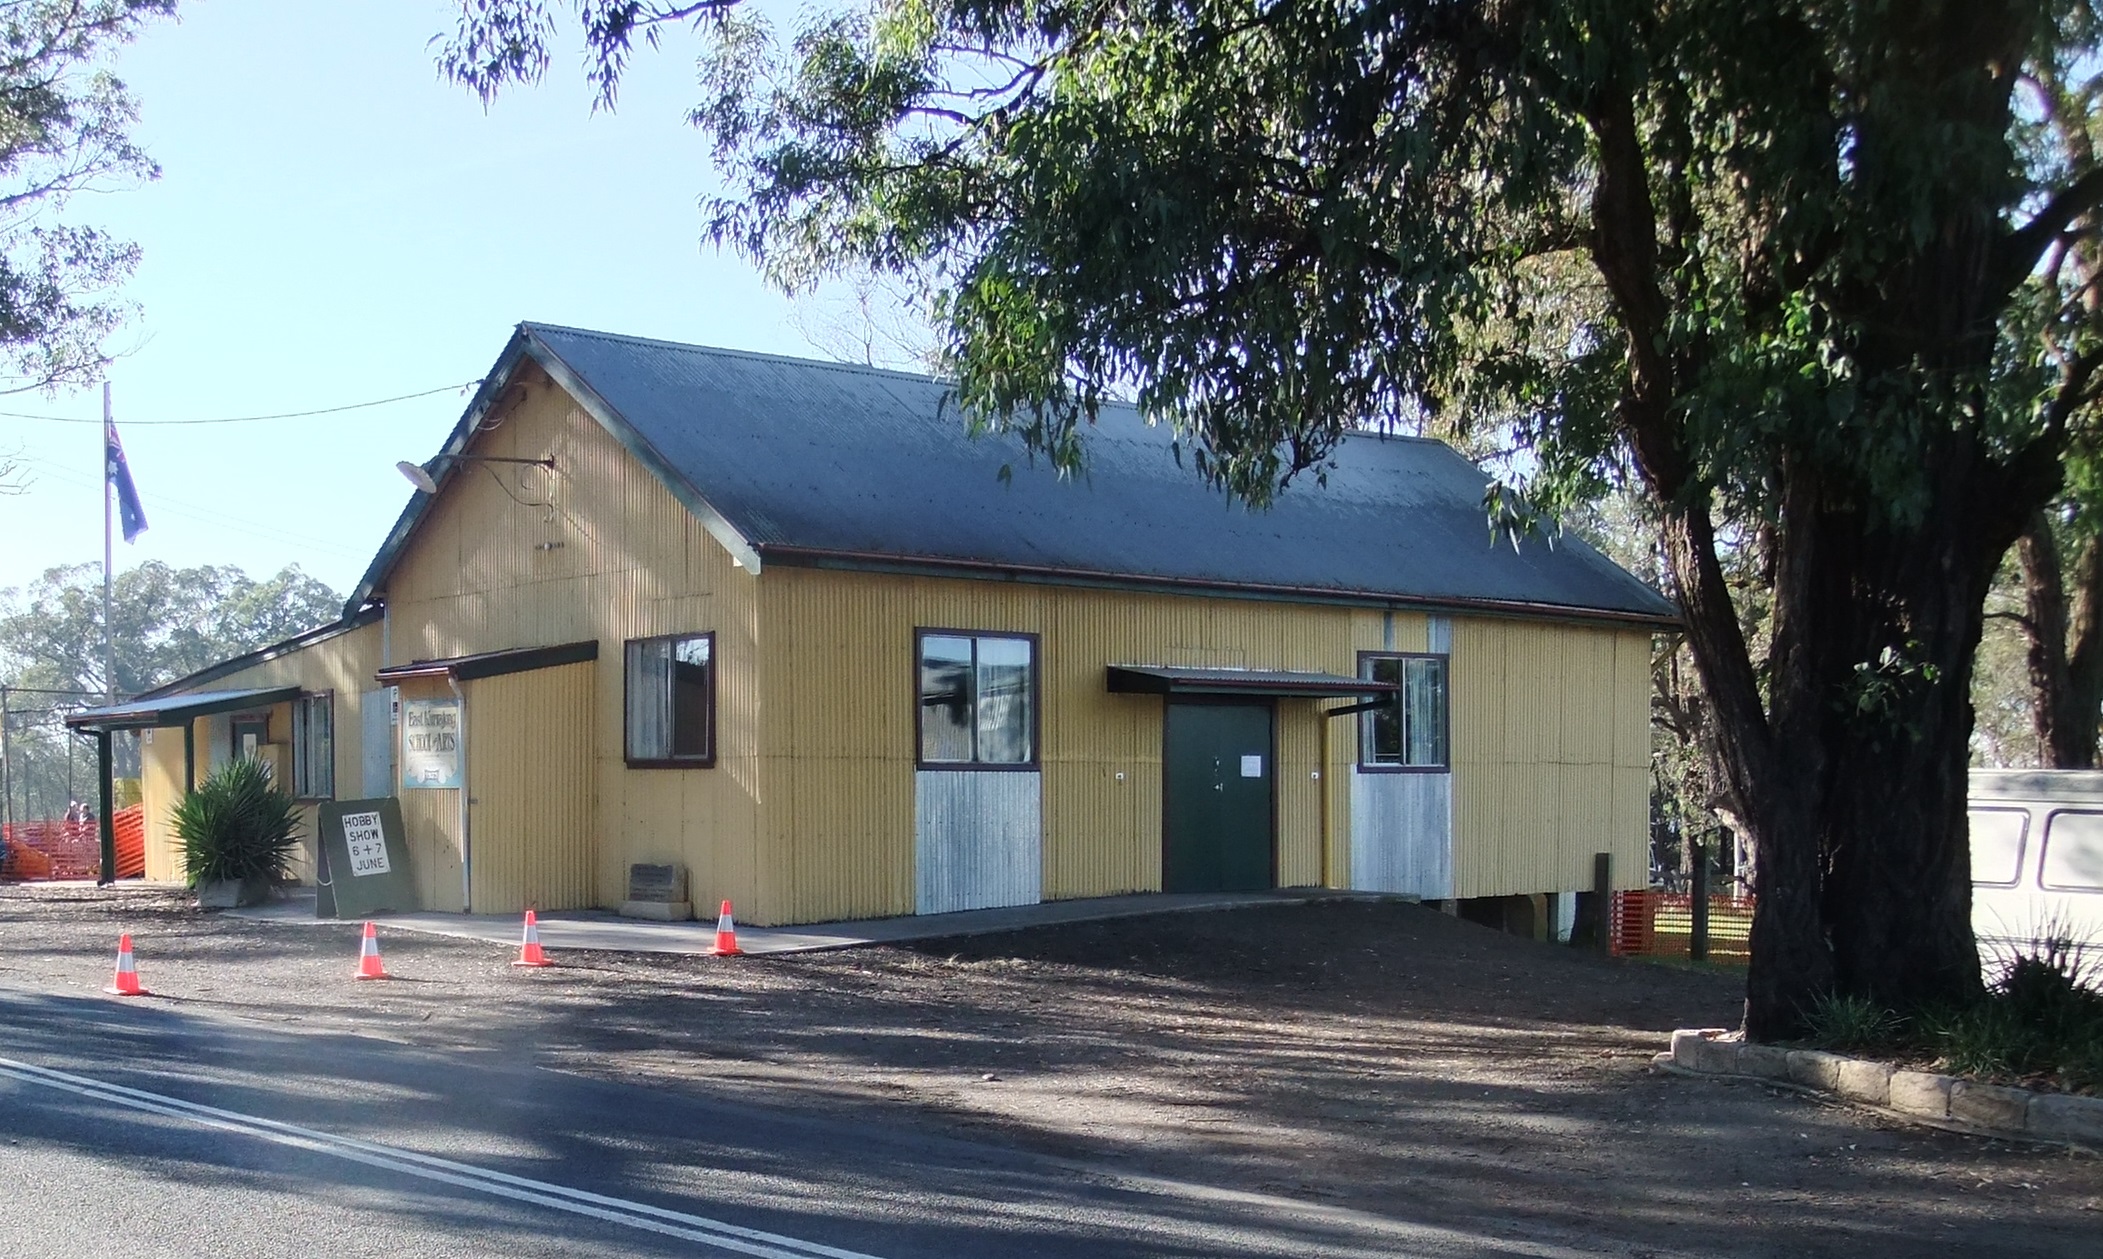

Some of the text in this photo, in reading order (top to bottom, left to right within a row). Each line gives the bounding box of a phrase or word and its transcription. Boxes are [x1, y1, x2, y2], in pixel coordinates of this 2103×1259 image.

[409, 709, 457, 729] East Kurrajong
[408, 733, 431, 752] SCHOOL
[437, 732, 456, 752] ARTS
[344, 814, 378, 828] HOBBY
[350, 829, 379, 842] SHOW
[352, 846, 360, 856] 6
[375, 843, 382, 853] 7
[357, 857, 385, 871] JUNE
